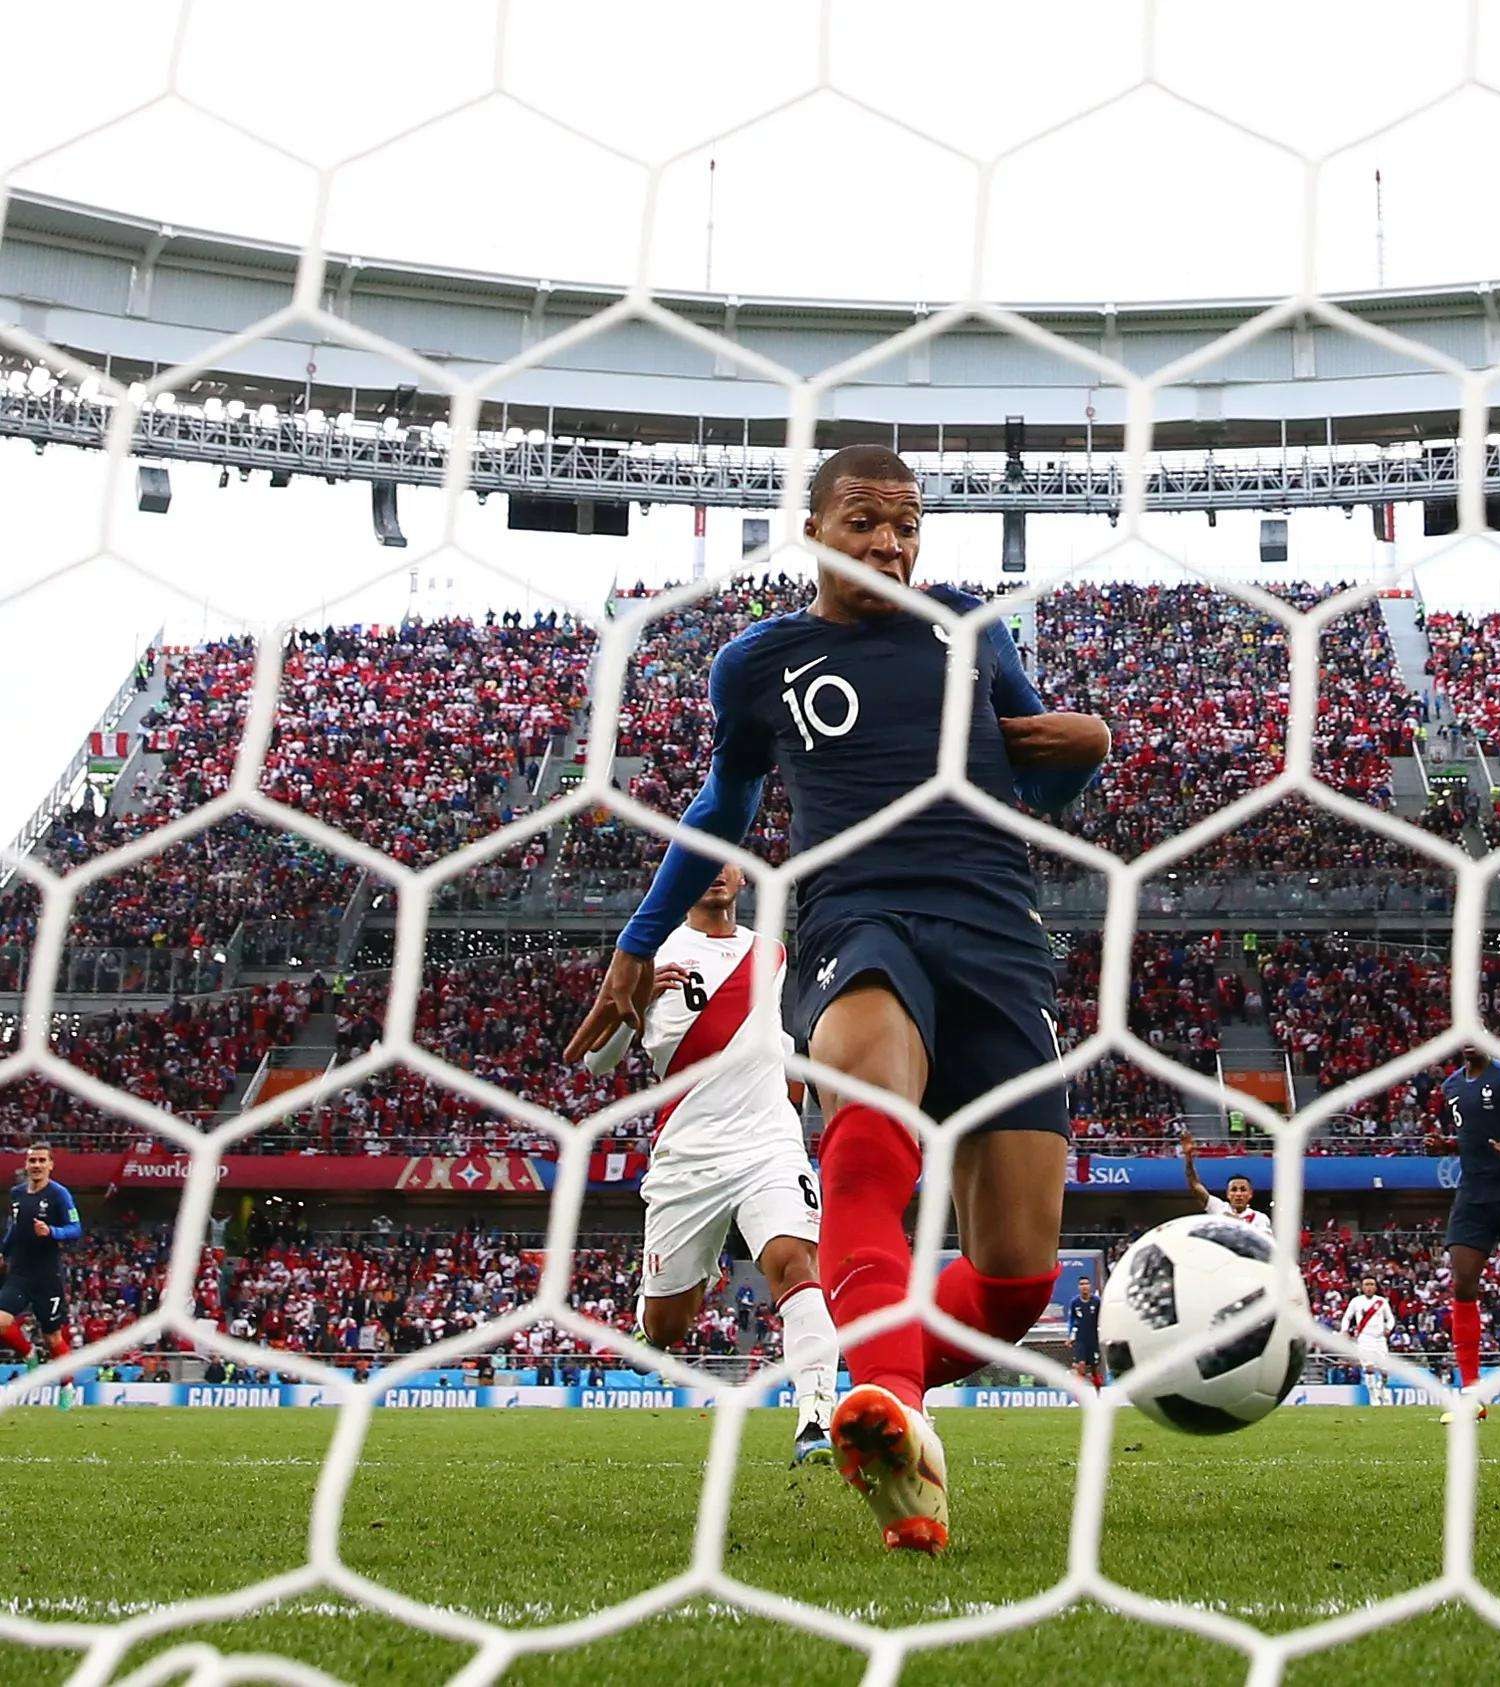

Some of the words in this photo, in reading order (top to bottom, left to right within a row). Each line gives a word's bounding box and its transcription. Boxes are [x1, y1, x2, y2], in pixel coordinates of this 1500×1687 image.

[782, 674, 859, 751] 10
[683, 971, 708, 1012] 6
[1453, 1104, 1463, 1127] 6
[798, 1174, 819, 1210] 6
[50, 1297, 61, 1314] 7
